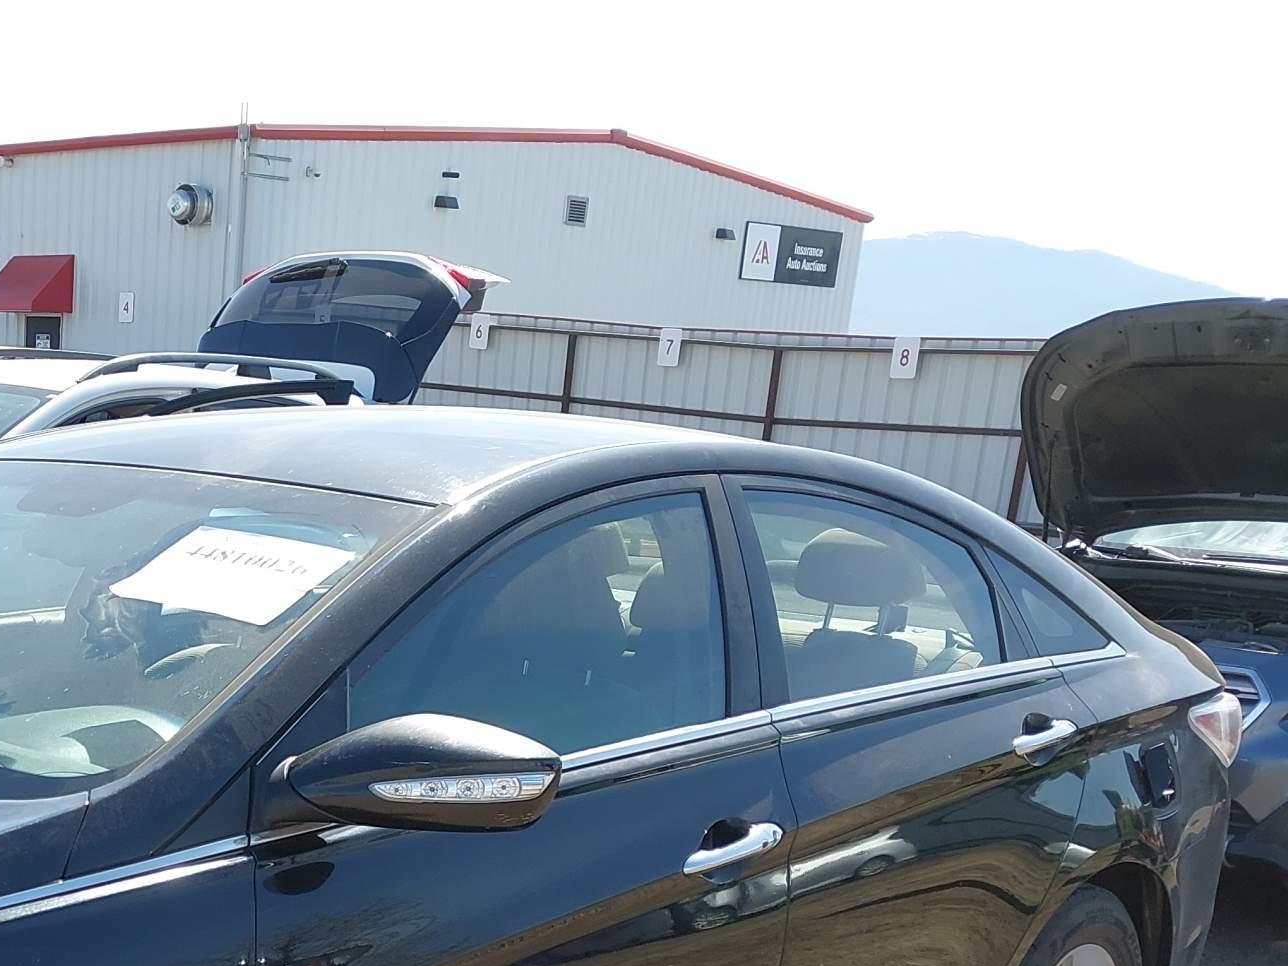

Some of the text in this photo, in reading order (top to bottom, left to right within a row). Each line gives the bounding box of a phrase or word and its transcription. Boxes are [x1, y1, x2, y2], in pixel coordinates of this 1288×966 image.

[794, 242, 824, 257] Insurance
[786, 257, 828, 273] Auto Auctions
[122, 301, 129, 314] 4
[475, 324, 483, 339] 6
[666, 339, 674, 355] 7
[899, 348, 910, 367] 8
